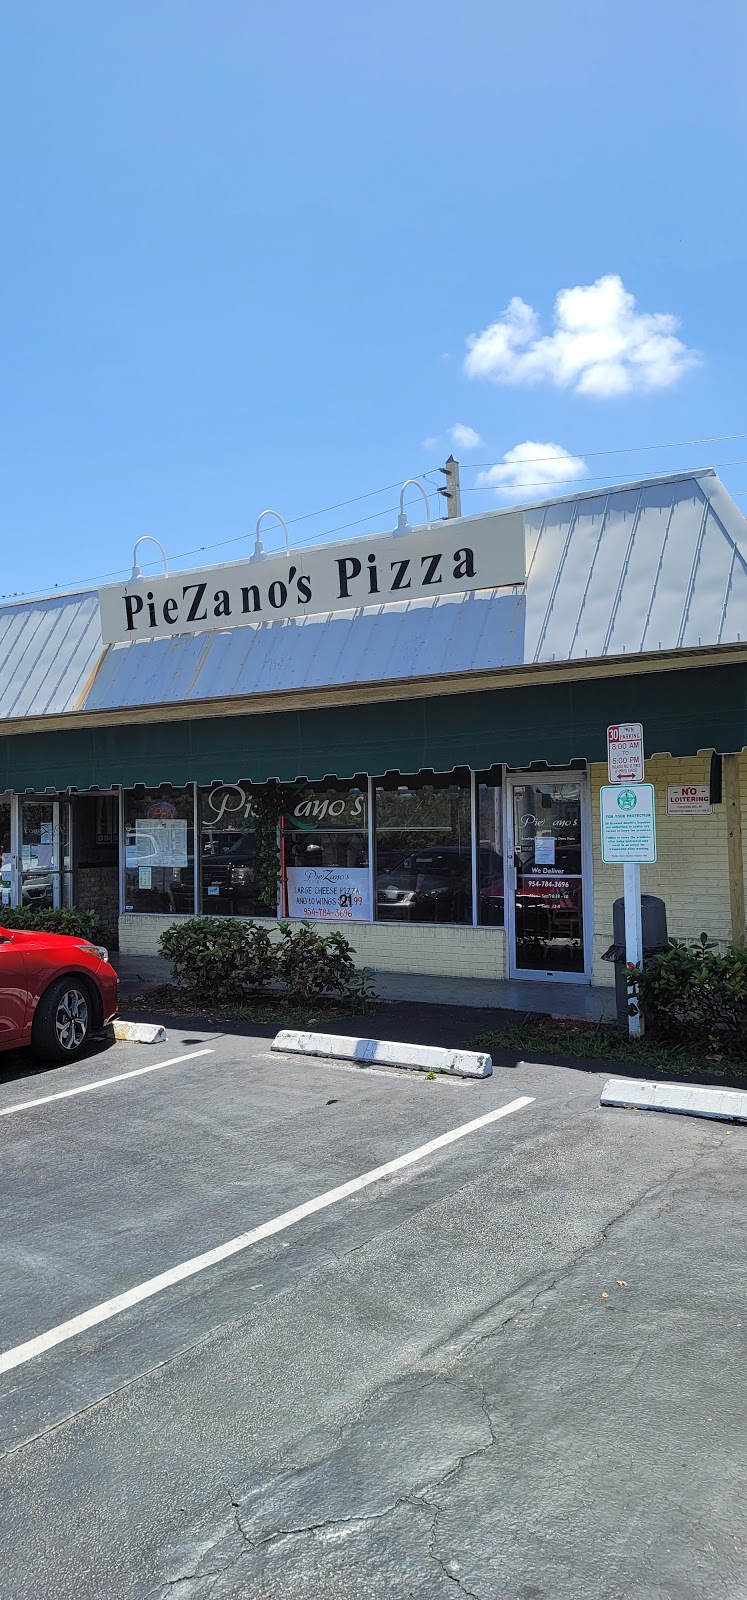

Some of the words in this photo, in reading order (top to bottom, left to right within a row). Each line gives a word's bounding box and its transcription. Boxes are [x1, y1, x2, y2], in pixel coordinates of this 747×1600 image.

[122, 566, 311, 631] PieZano's
[334, 547, 477, 599] Pizza
[608, 728, 619, 741] 30
[619, 732, 640, 740] PARKING
[611, 742, 627, 750] 8:00
[612, 757, 628, 765] 5:00
[629, 756, 640, 764] PM
[681, 787, 697, 796] NO
[303, 869, 350, 884] PieZano's
[527, 880, 570, 888] 954-784-3696
[294, 886, 312, 895] LARGE
[314, 886, 338, 896] CHEESE
[339, 886, 361, 895] PIZZA
[296, 897, 308, 905] AND
[316, 897, 337, 906] WINGS
[303, 907, 353, 918] 954-784-3696
